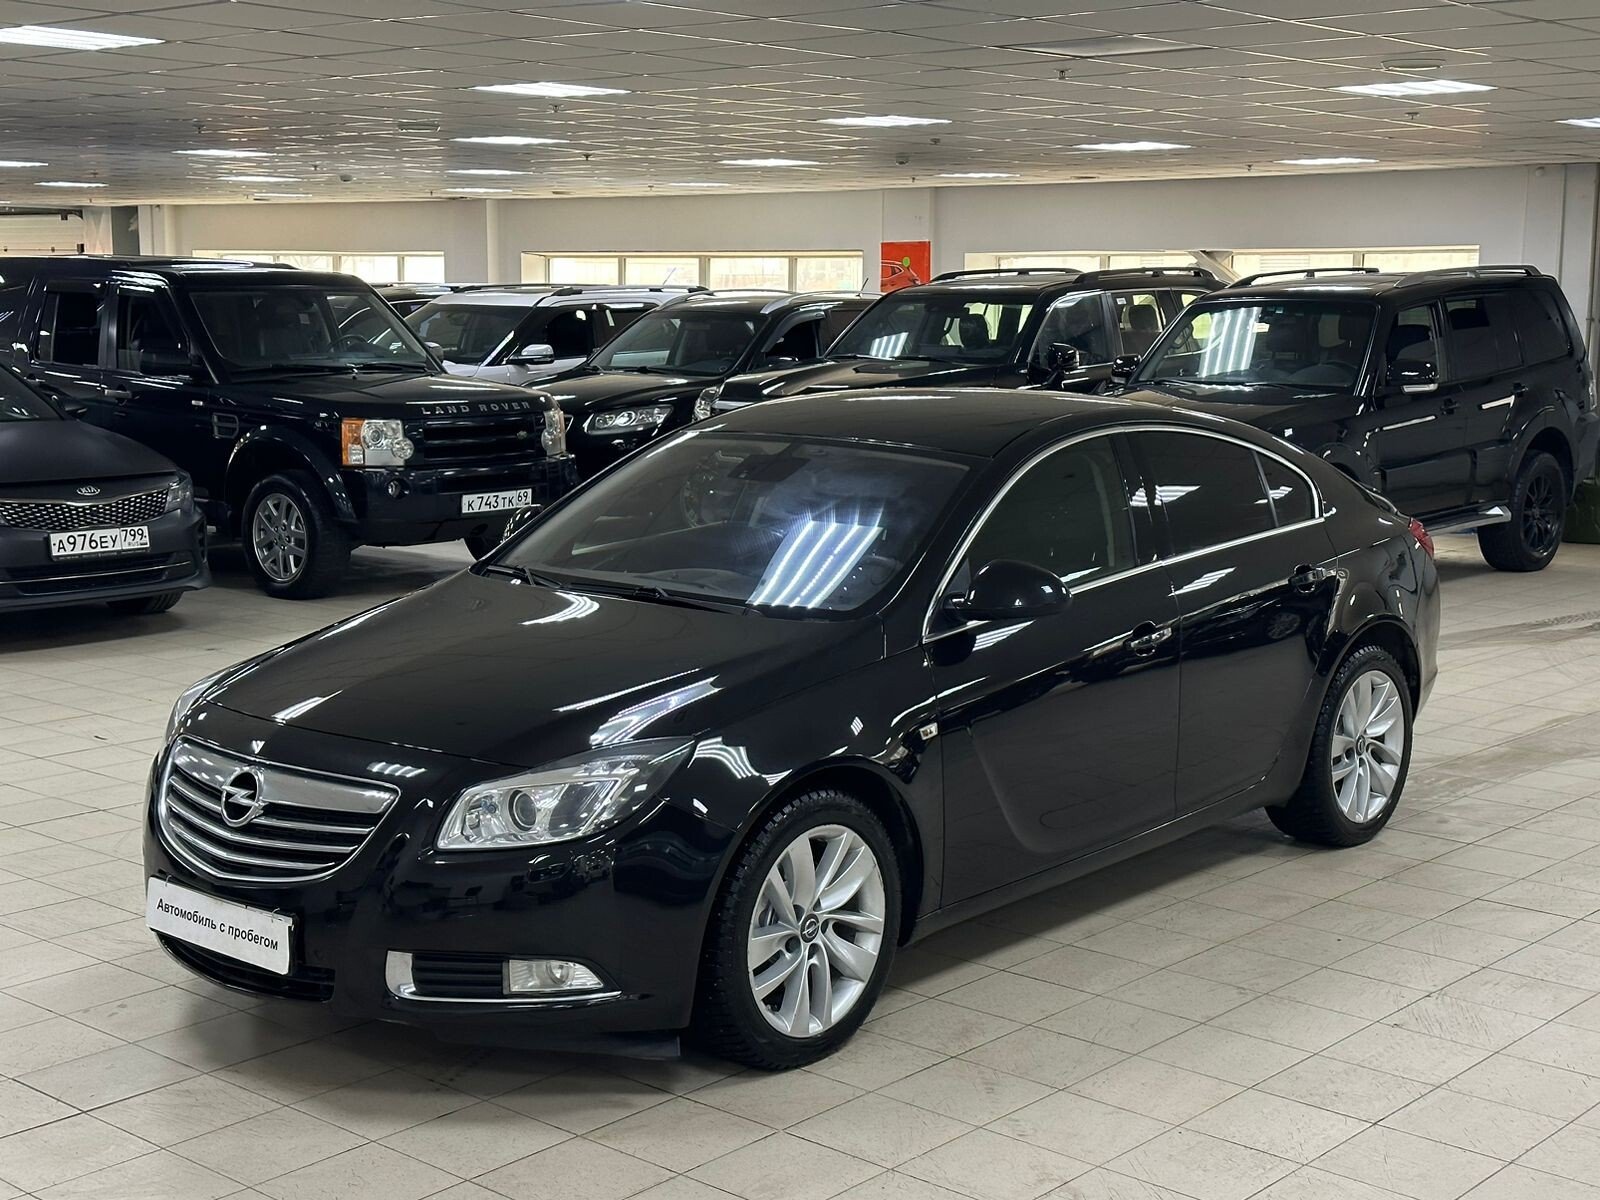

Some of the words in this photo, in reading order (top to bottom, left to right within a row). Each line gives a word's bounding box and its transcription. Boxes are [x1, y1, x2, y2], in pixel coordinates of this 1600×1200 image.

[421, 405, 470, 415] LAND
[478, 401, 530, 412] ROVER
[517, 490, 529, 502] 69
[121, 528, 144, 542] 799
[156, 898, 217, 930] Автомобиль
[219, 922, 226, 933] с
[227, 925, 279, 951] пробегом
